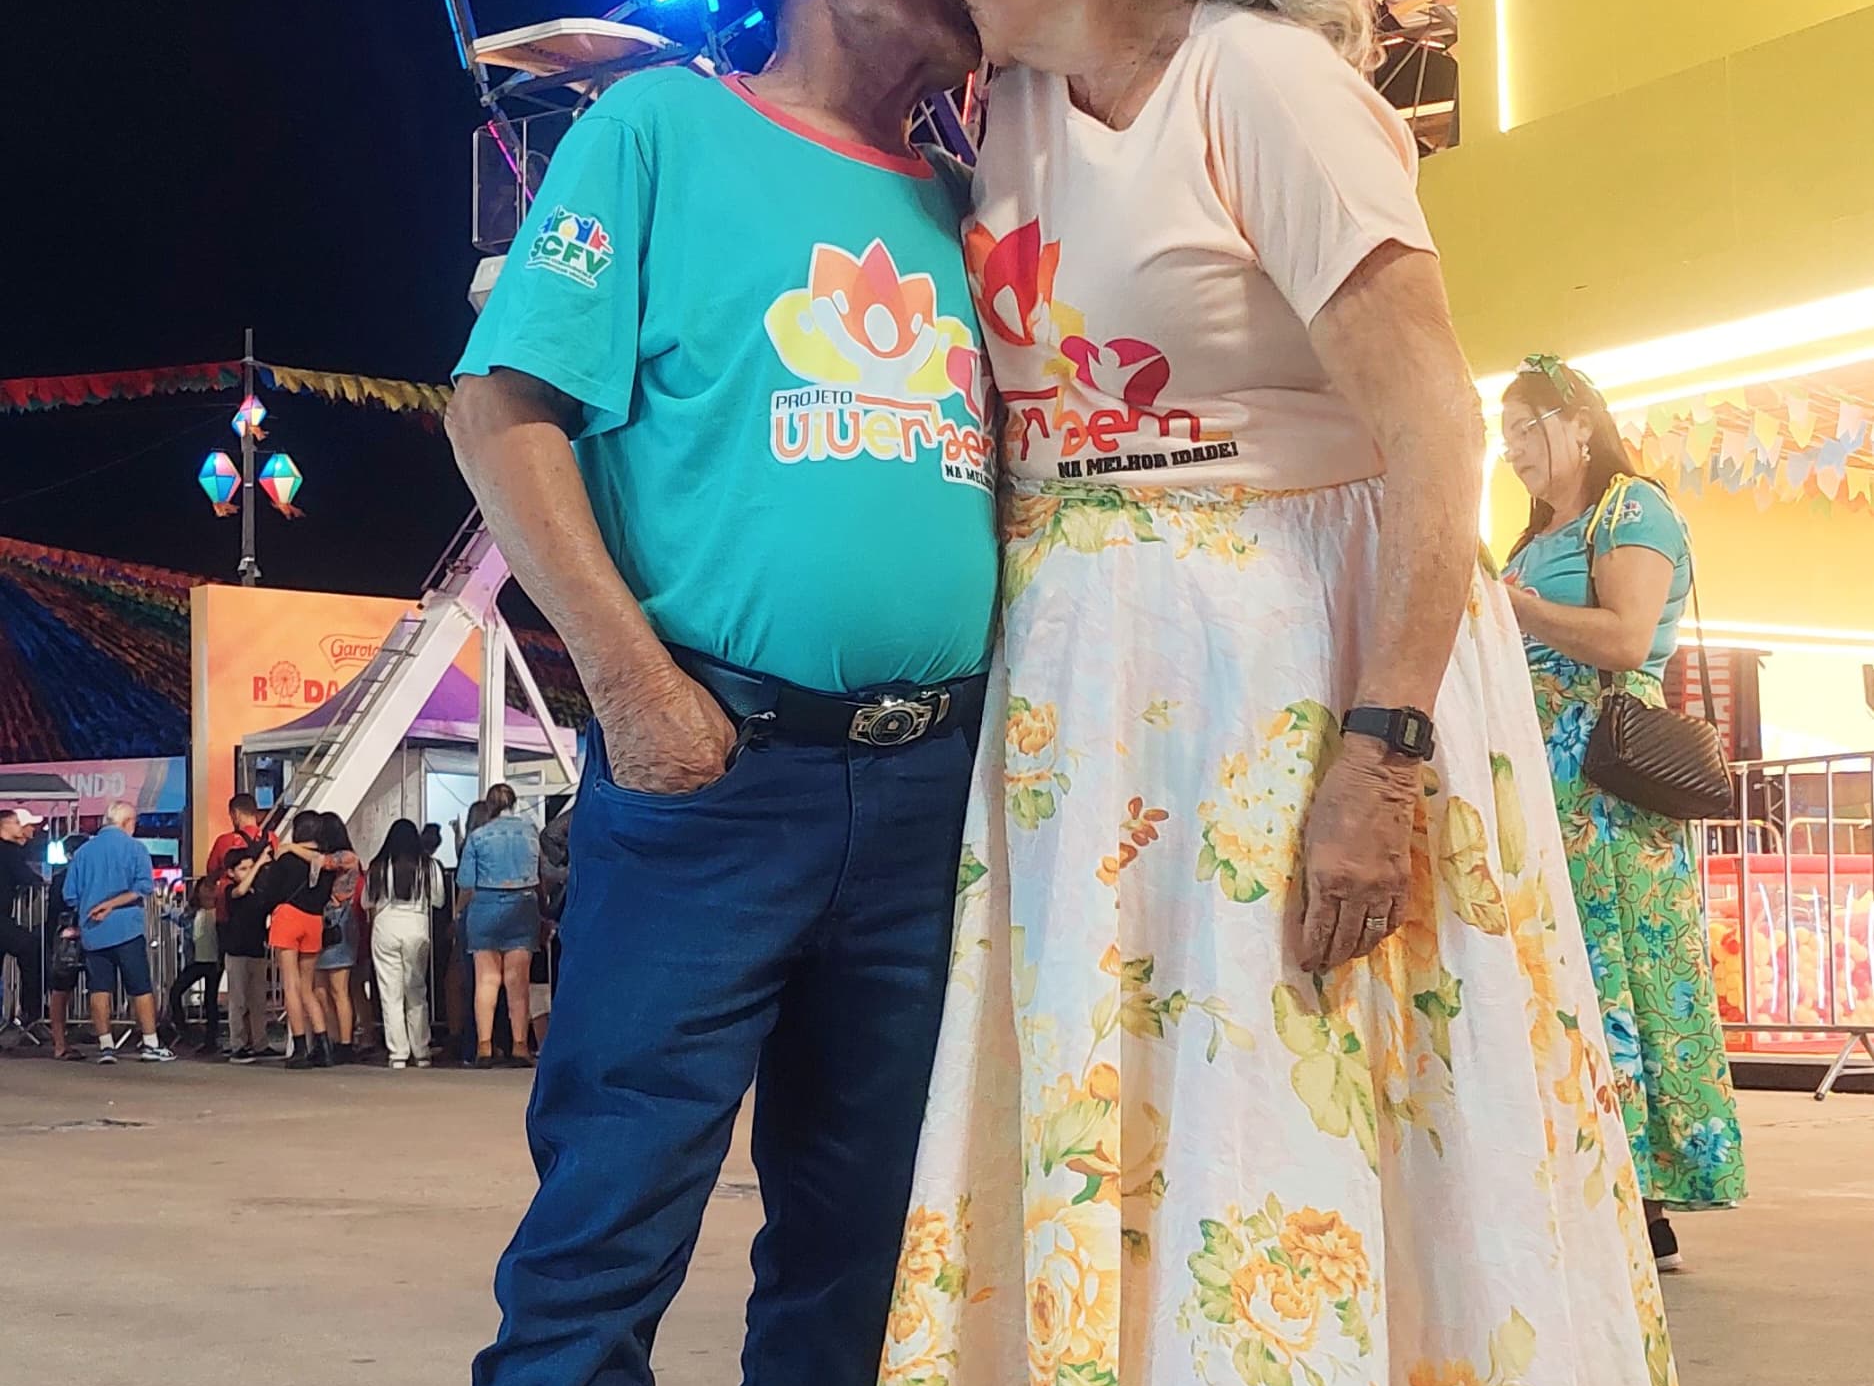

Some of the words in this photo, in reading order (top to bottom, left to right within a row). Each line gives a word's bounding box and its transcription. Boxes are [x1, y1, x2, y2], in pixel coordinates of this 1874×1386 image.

[530, 234, 609, 274] SCFV
[775, 390, 853, 410] PROJETO
[945, 463, 963, 480] NA
[1057, 460, 1083, 479] NA
[1086, 453, 1168, 477] MELHOR
[1171, 441, 1239, 466] IDADE!
